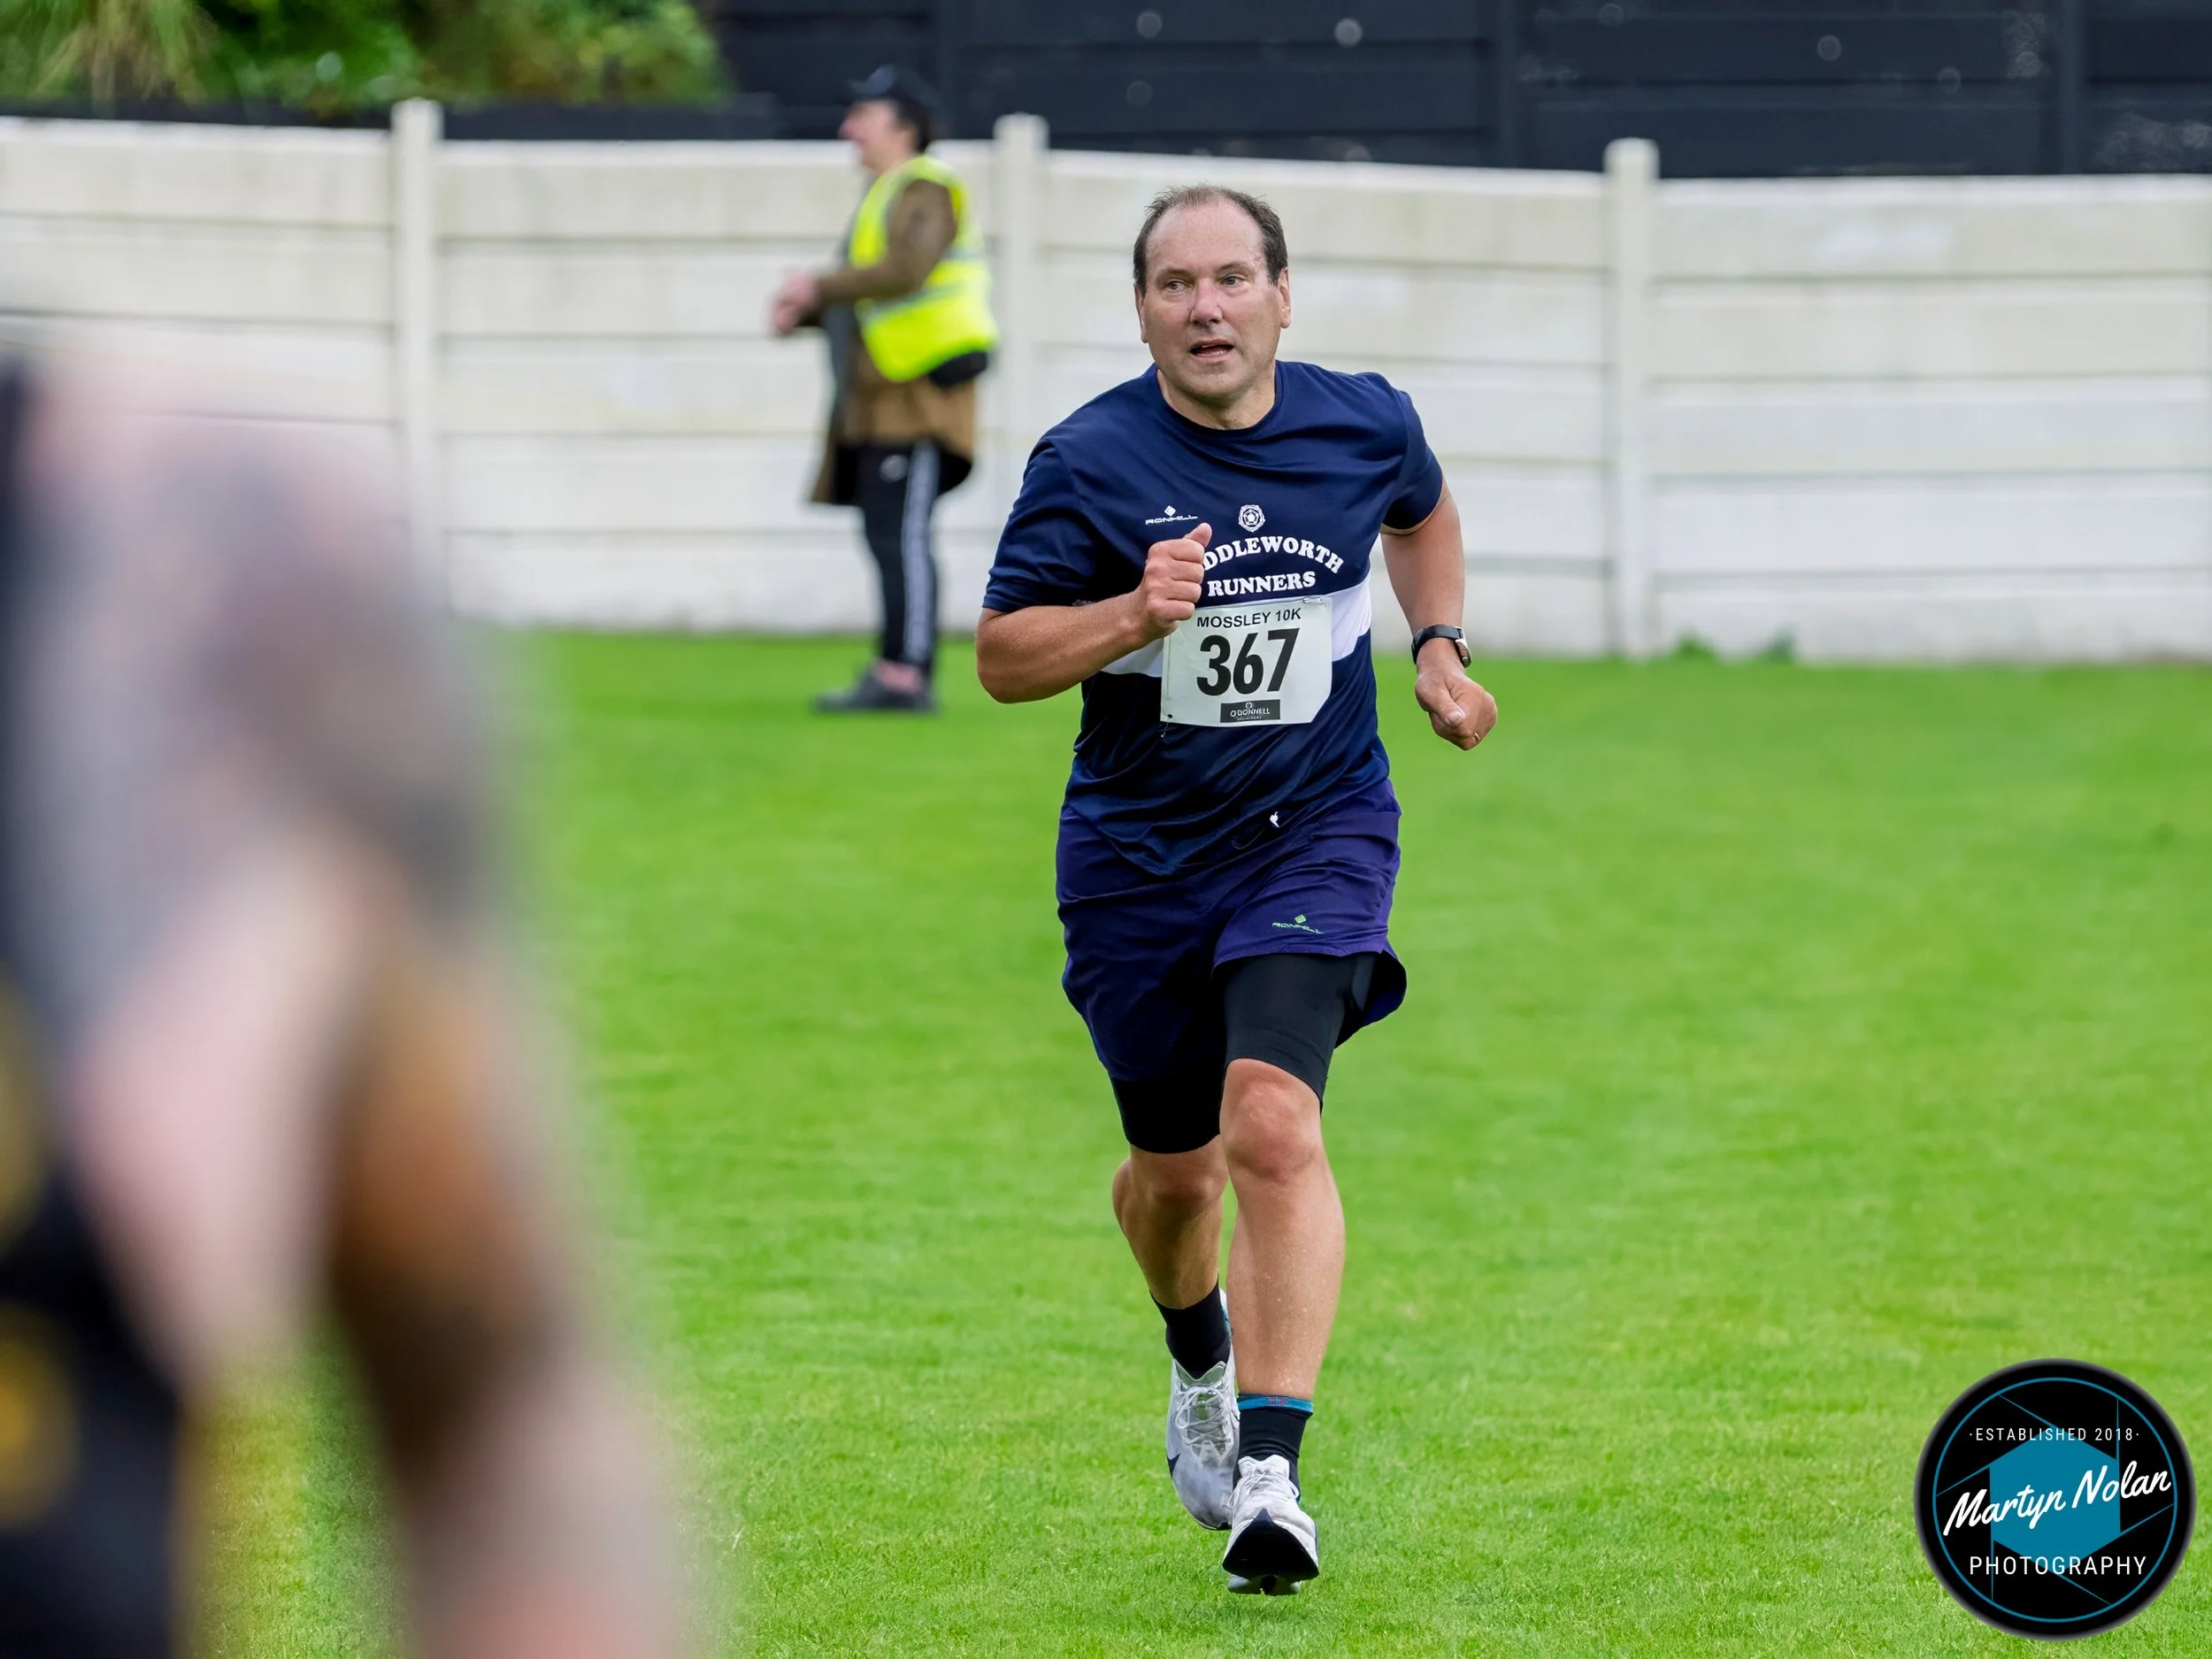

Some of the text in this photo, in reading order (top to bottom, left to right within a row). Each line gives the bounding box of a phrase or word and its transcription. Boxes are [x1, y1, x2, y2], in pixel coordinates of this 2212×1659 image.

[1204, 535, 1344, 573] DDLEWORTH
[1208, 571, 1317, 597] RUNNERS
[1197, 608, 1302, 628] MOSSLEY 10K
[1196, 627, 1300, 696] 367
